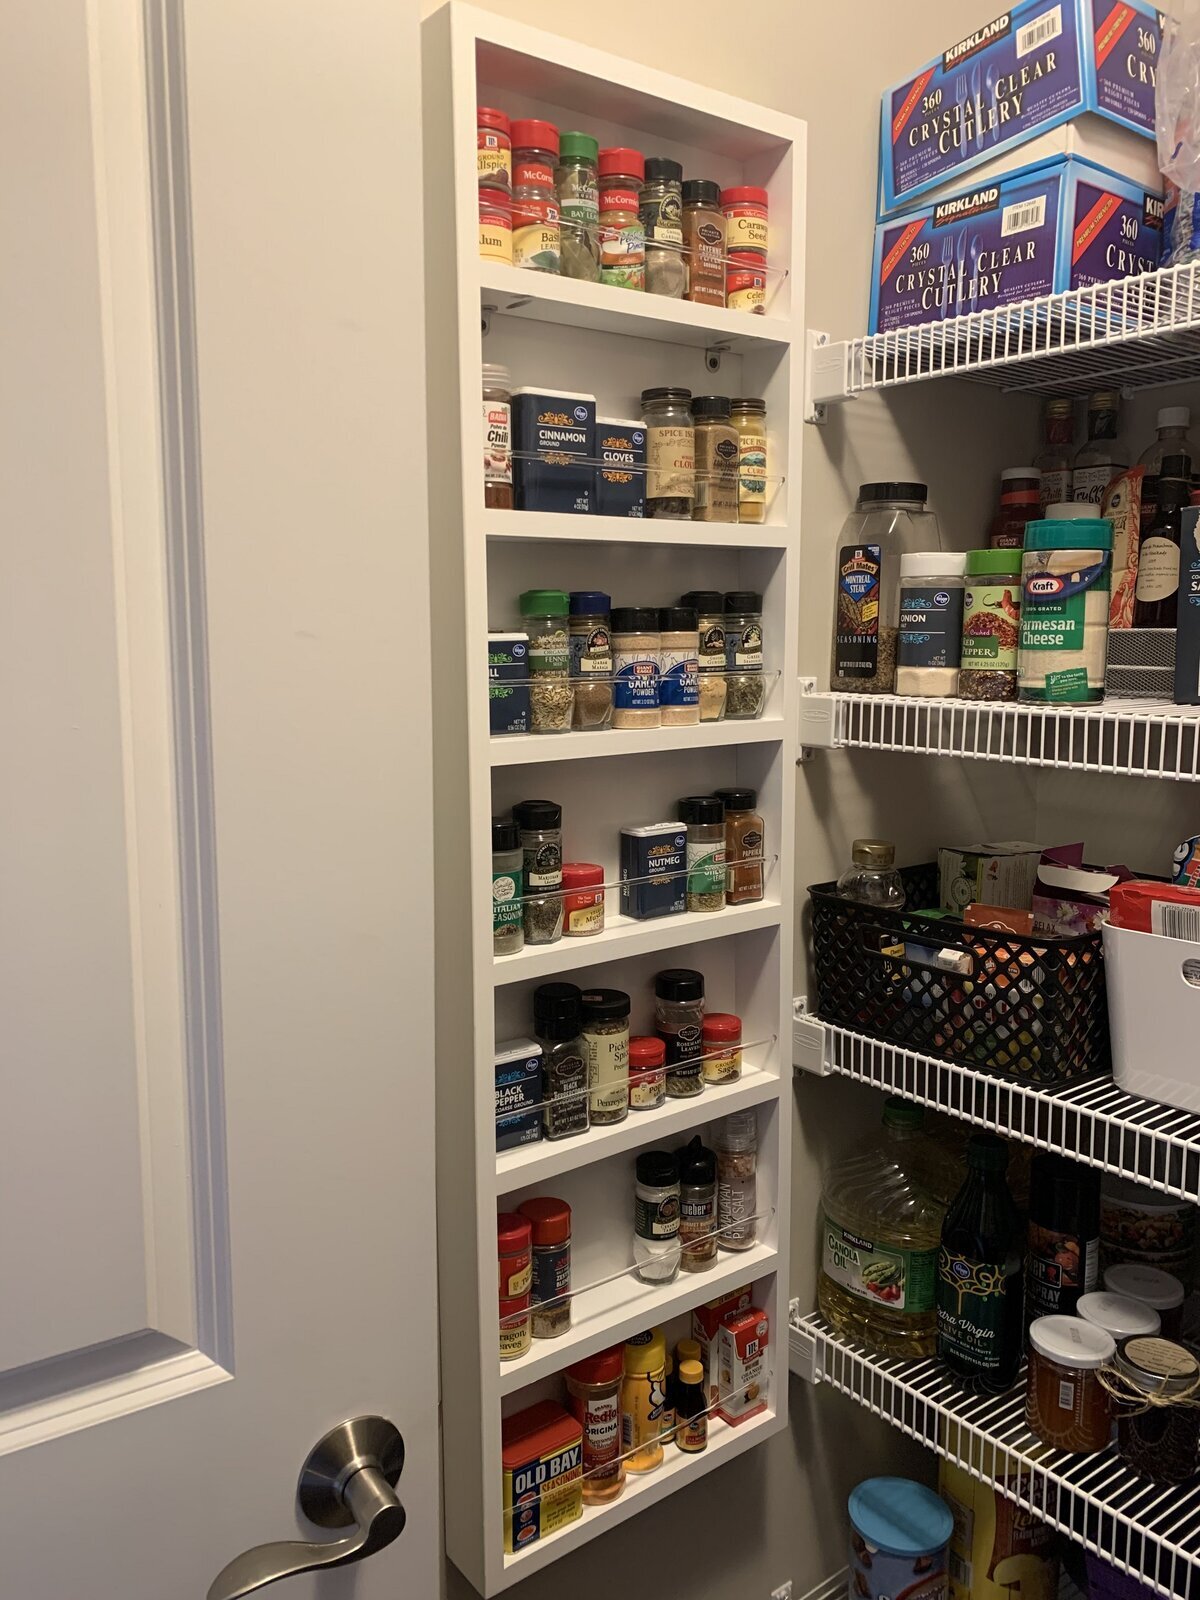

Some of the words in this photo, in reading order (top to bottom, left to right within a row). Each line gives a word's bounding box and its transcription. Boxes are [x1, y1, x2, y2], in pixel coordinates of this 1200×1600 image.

[945, 15, 1009, 63] KIRKLAND
[1138, 27, 1155, 54] 360
[909, 92, 985, 147] CRYSTAL
[995, 52, 1056, 99] CLEAR
[922, 89, 942, 113] 360
[939, 93, 1023, 154] CUTLERY
[477, 160, 507, 171] llspice
[936, 188, 998, 218] KIRKLAND
[571, 209, 584, 218] BAY
[1120, 214, 1138, 240] 360
[479, 233, 502, 246] lum
[910, 243, 930, 263] 360
[895, 260, 968, 294] CRYSTAL
[977, 241, 1036, 272] CLEAR
[922, 272, 1002, 310] CUTLERY
[487, 431, 508, 444] Chili
[539, 430, 586, 443] CINNAMON
[603, 452, 634, 463] CLOVES
[843, 562, 855, 572] Grill
[855, 562, 876, 572] Mates
[845, 574, 871, 584] MONTREAL
[849, 584, 865, 593] STEAK
[1032, 581, 1054, 591] Kraft
[900, 614, 926, 622] ONION
[836, 635, 878, 644] SEASONING
[1022, 633, 1064, 645] Cheese
[648, 856, 680, 868] NUTMEG
[717, 1065, 735, 1074] Sage
[563, 1082, 578, 1091] BLACK
[732, 1190, 745, 1213] SALT
[681, 1204, 706, 1215] weber
[828, 1234, 860, 1264] CANOLA
[834, 1252, 847, 1269] OIL
[959, 1319, 995, 1339] Virgin
[515, 1467, 546, 1495] OLD
[550, 1447, 580, 1476] BAY
